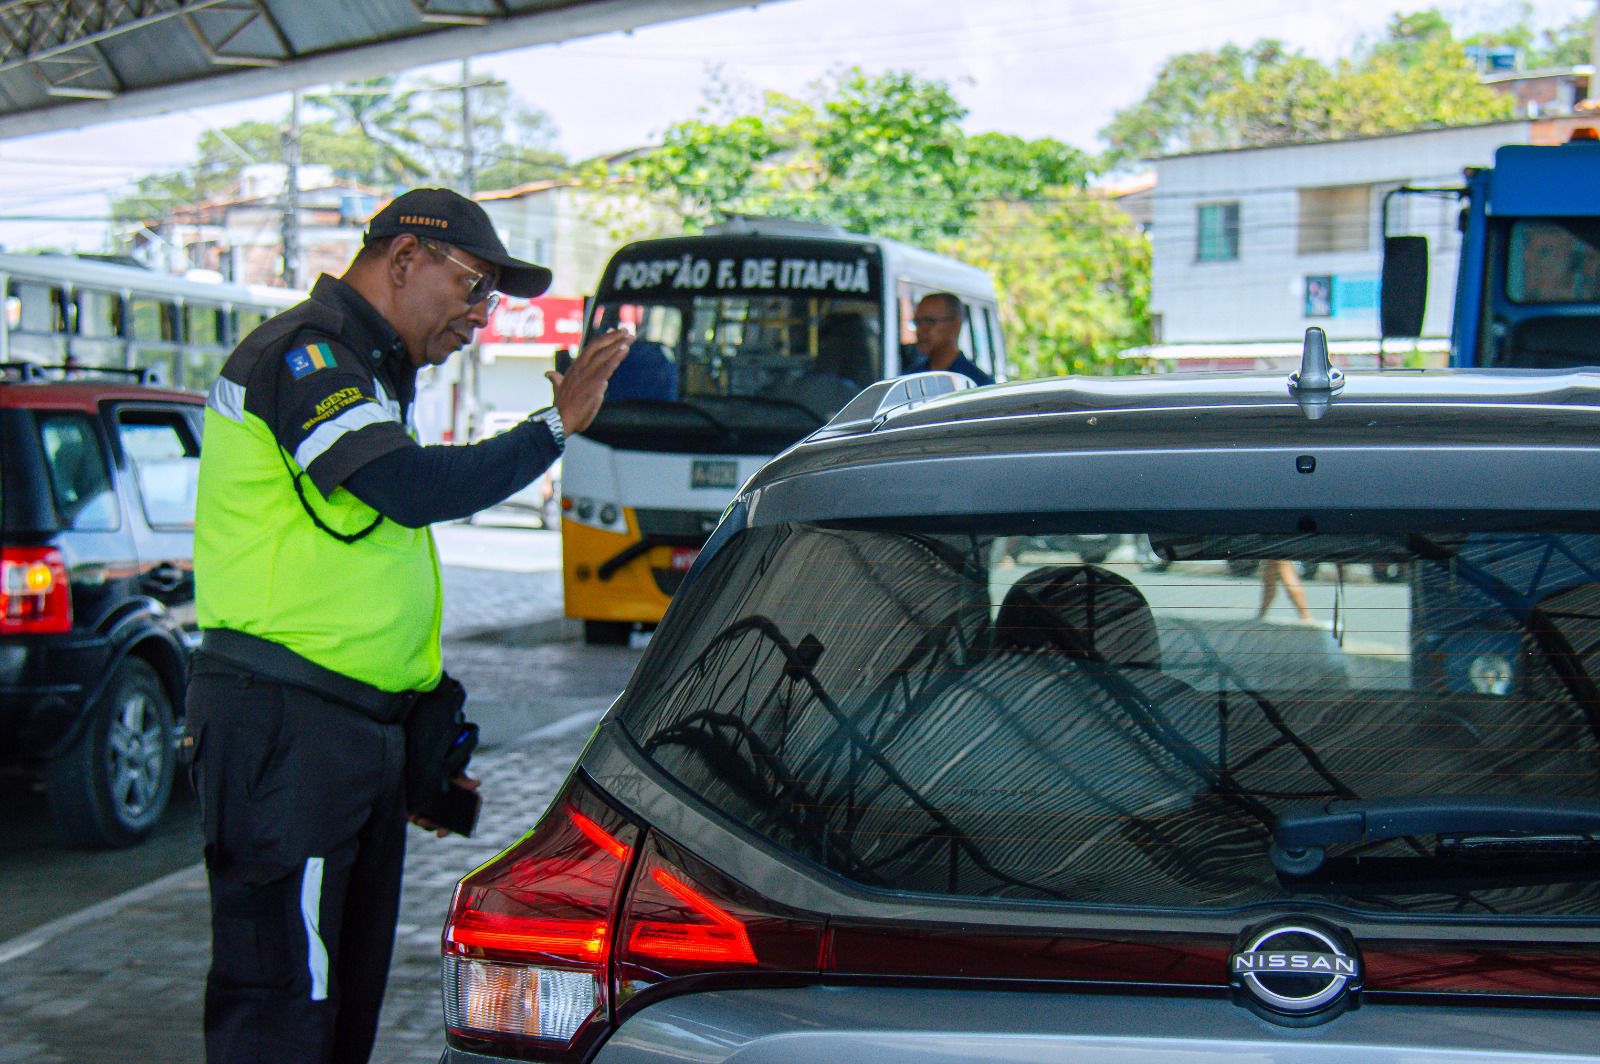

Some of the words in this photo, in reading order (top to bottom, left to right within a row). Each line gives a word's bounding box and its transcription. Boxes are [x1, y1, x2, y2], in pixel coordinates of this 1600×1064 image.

[741, 260, 776, 290] DE
[315, 387, 360, 415] AGENTE
[1236, 954, 1354, 972] NISSAN
